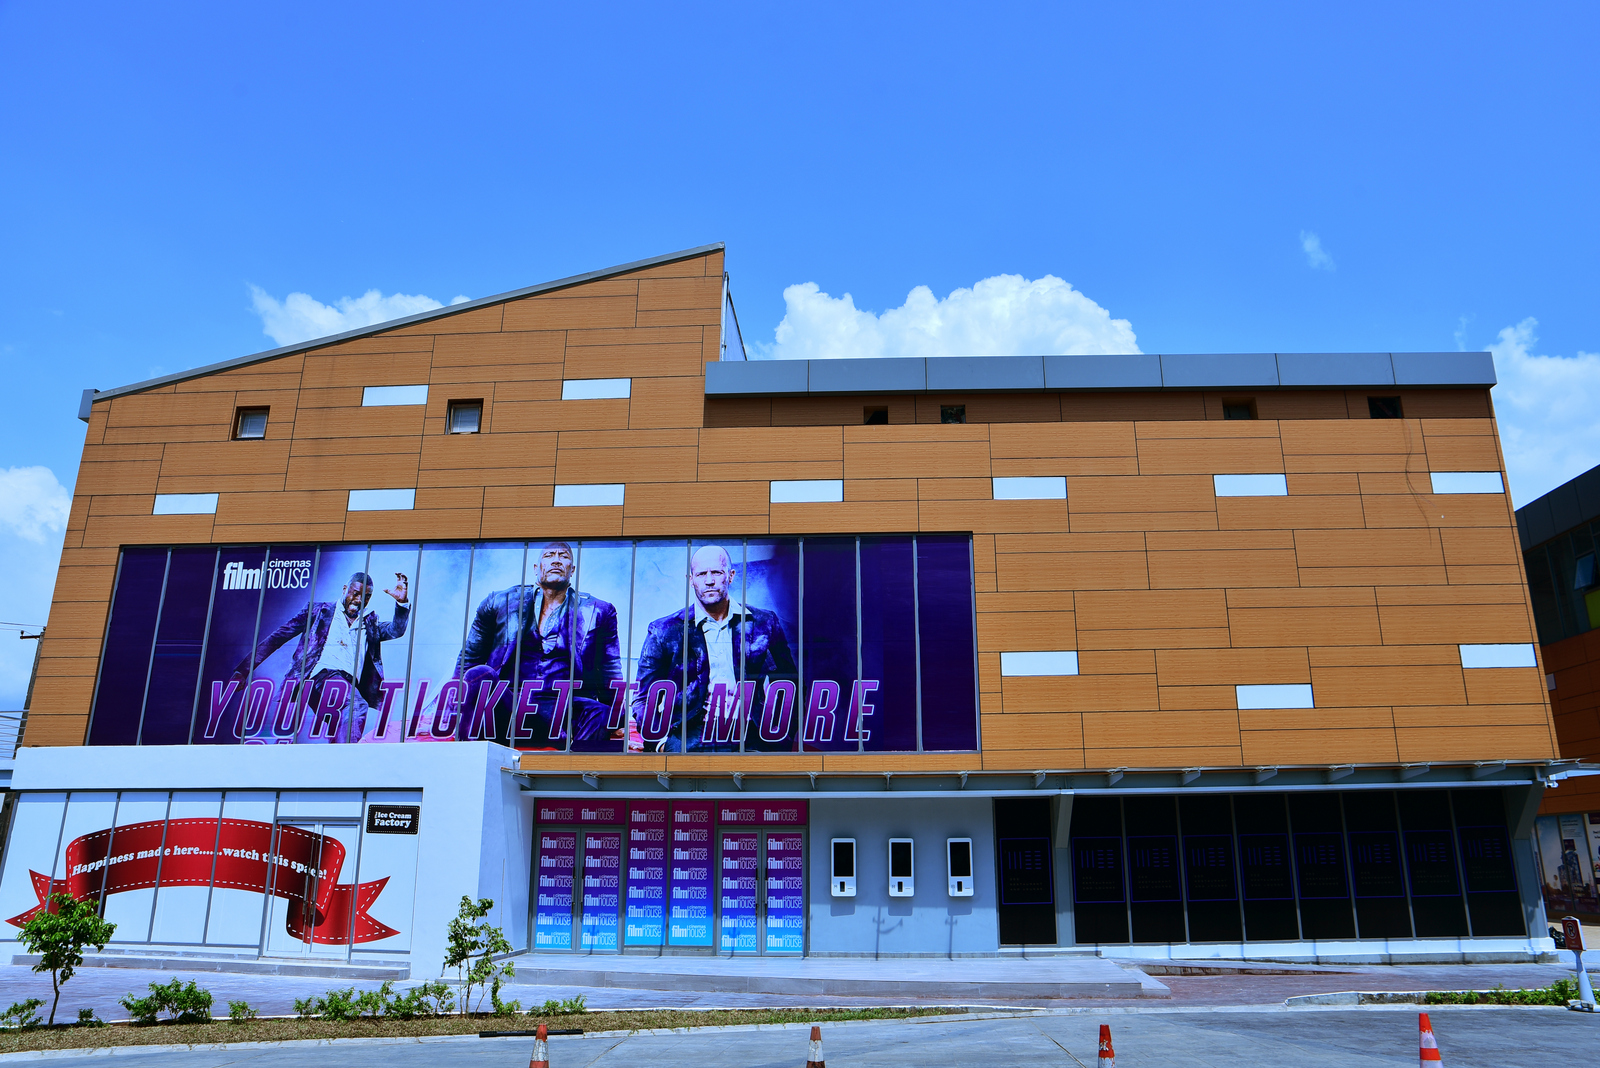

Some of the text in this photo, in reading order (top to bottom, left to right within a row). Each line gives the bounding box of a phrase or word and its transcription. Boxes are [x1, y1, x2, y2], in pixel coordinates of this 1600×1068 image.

[269, 558, 311, 568] cinemas
[202, 679, 880, 742] YOUR TICKET TO MORE
[374, 819, 411, 828] Factory
[72, 852, 134, 876] Happiness
[136, 846, 171, 859] made
[262, 850, 288, 867] this
